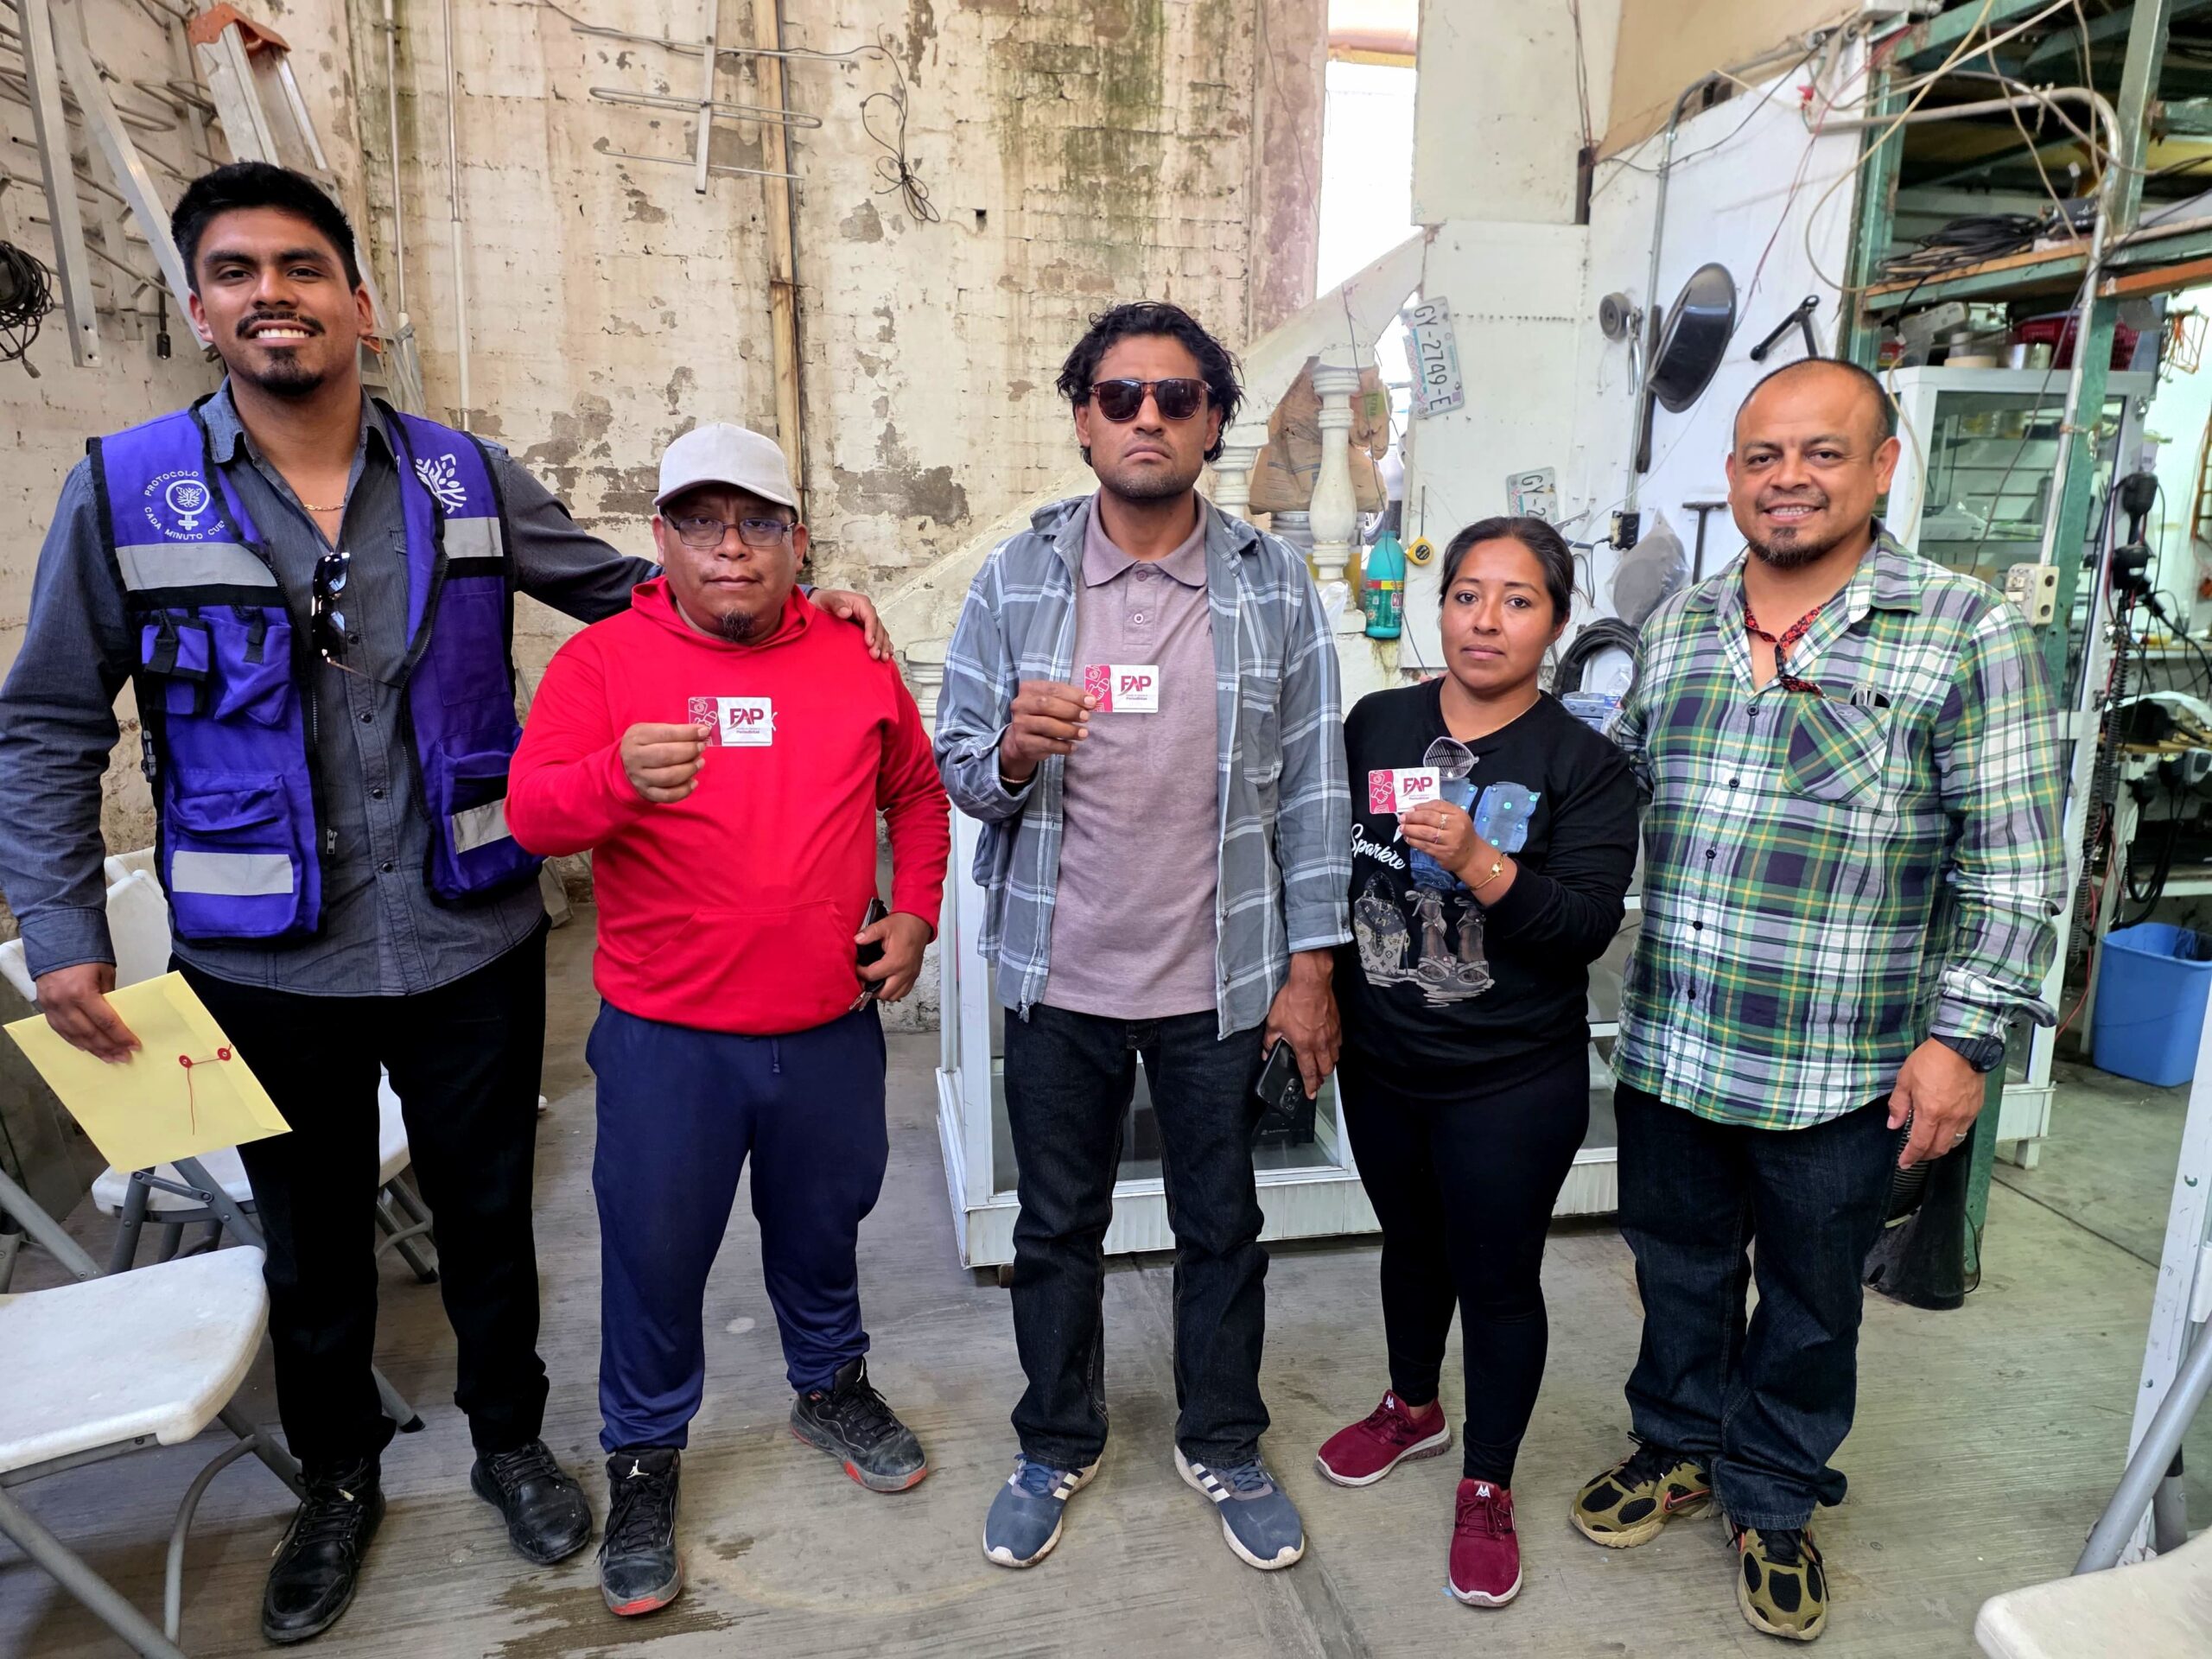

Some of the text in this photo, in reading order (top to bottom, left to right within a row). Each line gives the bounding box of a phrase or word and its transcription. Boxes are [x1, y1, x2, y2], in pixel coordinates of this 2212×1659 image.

[1414, 304, 1452, 411] GY-2749-E
[144, 470, 199, 497] PROTOCOLO
[1521, 474, 1548, 524] GY-2
[144, 507, 162, 530] CADA
[164, 528, 203, 540] MINUTO
[1117, 675, 1152, 696] FAP
[727, 708, 764, 730] FAP
[1402, 777, 1433, 797] FAP
[1351, 823, 1406, 869] Sparkle
